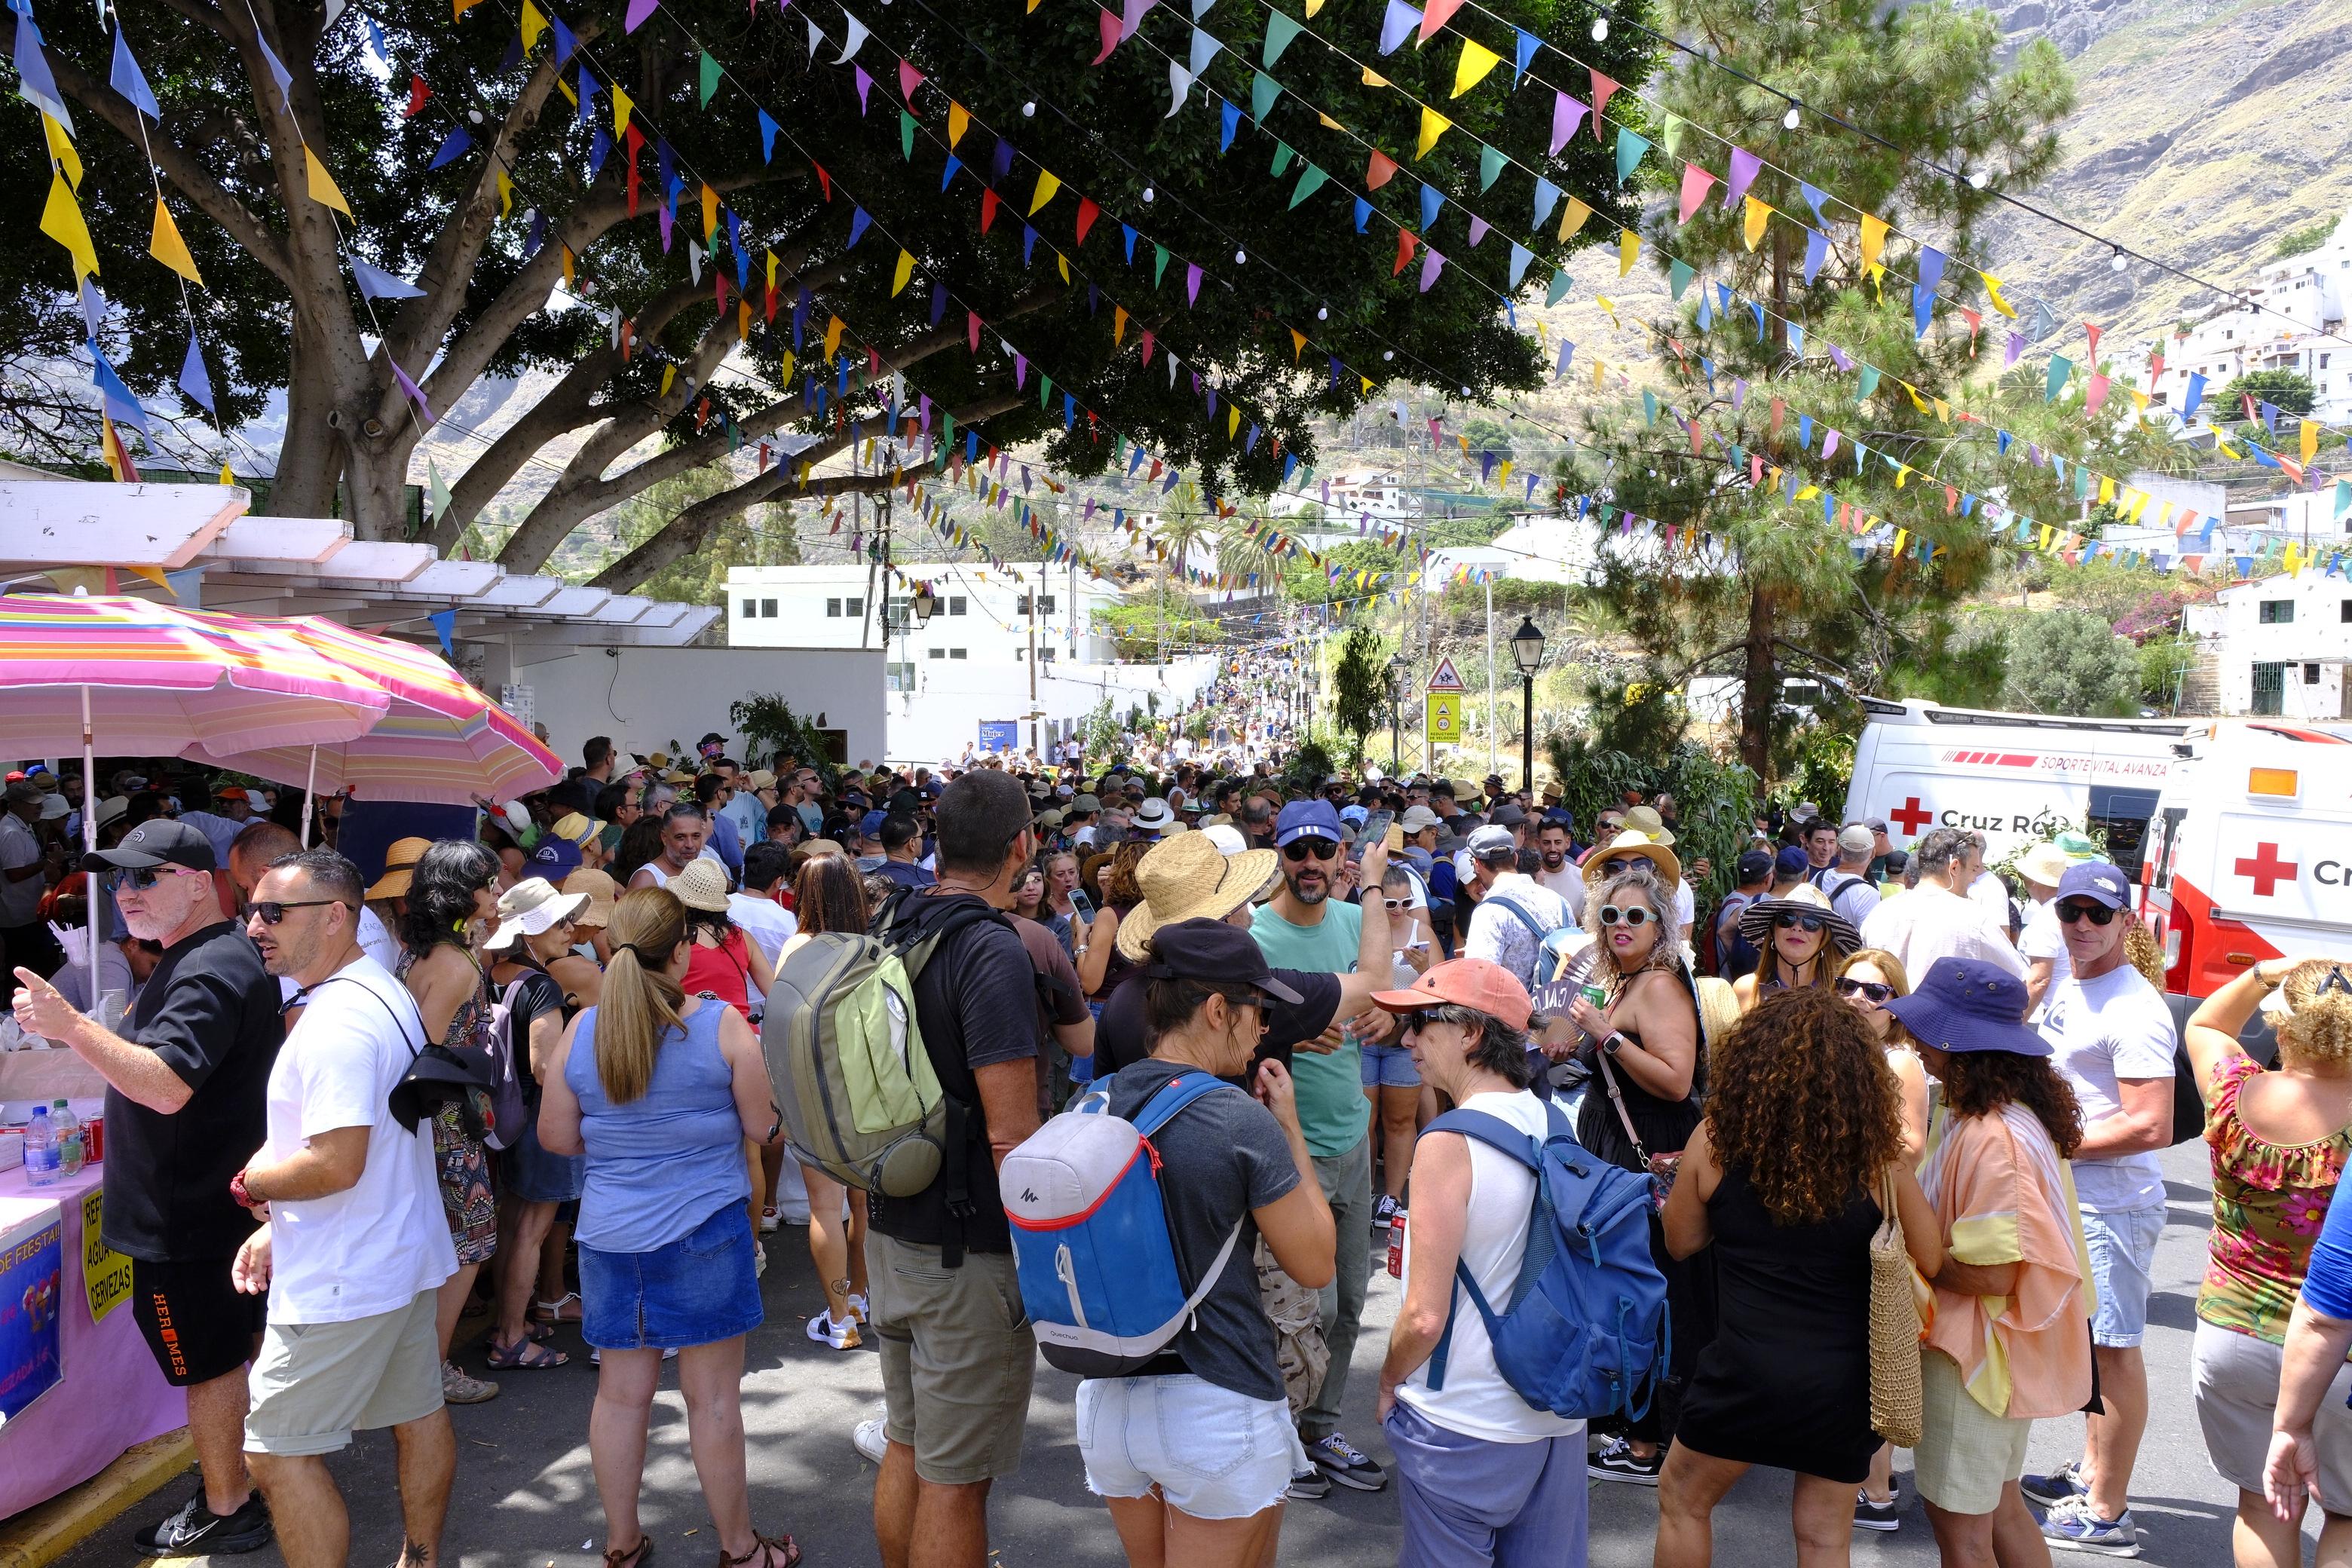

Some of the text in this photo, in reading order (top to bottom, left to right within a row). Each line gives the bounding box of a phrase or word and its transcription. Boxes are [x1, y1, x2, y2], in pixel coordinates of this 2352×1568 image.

[982, 730, 1004, 739] Mujer
[2041, 756, 2167, 777] SOPORTE VITAL AVANZA
[1940, 810, 2003, 831] Cruz
[15, 1223, 60, 1265] FIESTA!!
[90, 1264, 130, 1312] CERVEZAS
[1050, 1331, 1079, 1340] Quechua
